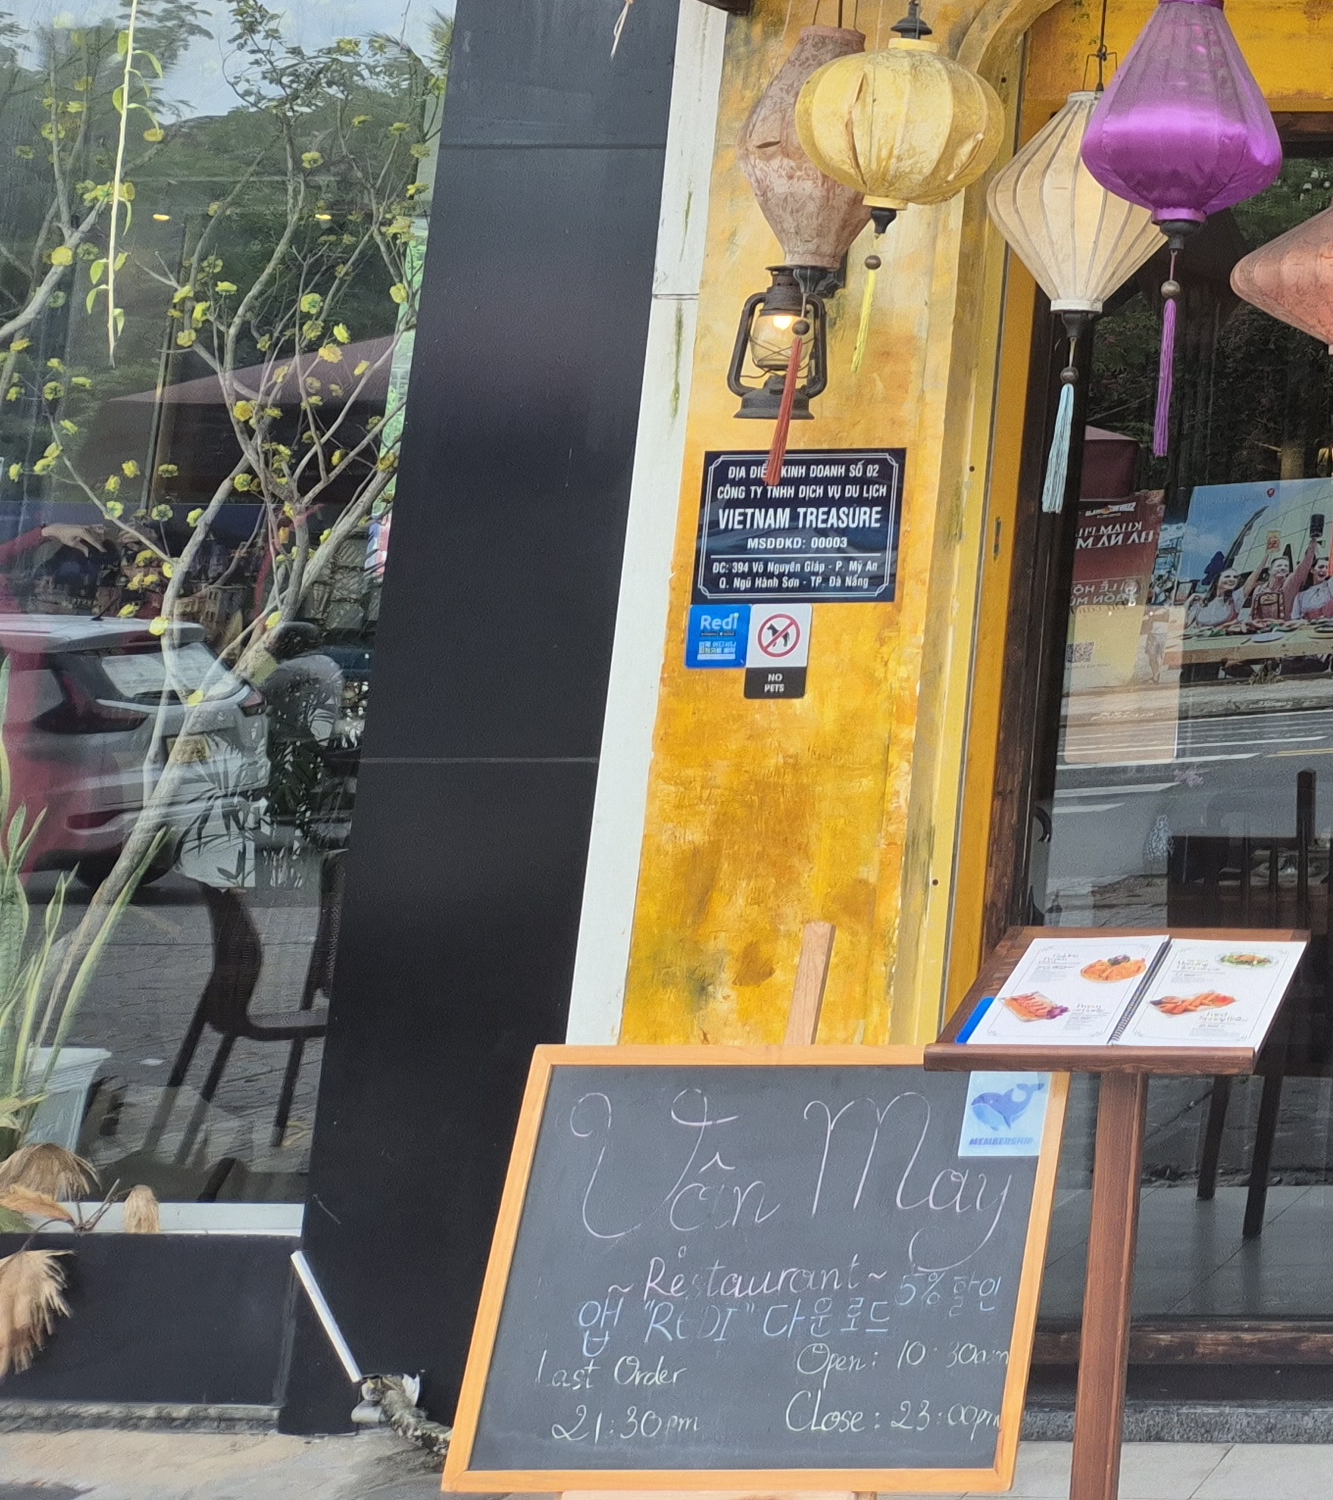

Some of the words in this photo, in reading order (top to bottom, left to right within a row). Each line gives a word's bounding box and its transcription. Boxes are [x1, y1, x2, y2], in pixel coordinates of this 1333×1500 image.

[781, 465, 806, 478] KINH
[809, 464, 845, 479] DOANH
[849, 460, 865, 478] SỐ
[866, 464, 879, 477] 02
[717, 484, 746, 499] CÔNG
[750, 486, 763, 499] TY
[766, 485, 795, 499] TNHH
[798, 485, 824, 501] DỊCH
[827, 485, 842, 500] VỤ
[845, 484, 859, 498] DU
[863, 484, 887, 500] LỊCH
[718, 507, 790, 530] VIETNAM
[797, 506, 882, 529] TREASURE
[810, 536, 848, 548] 00003
[732, 561, 749, 573] 394
[804, 560, 825, 575] Giáp
[849, 560, 863, 573] Mỹ
[866, 560, 878, 572] An
[755, 576, 778, 588] Hành
[782, 576, 800, 588] Sơn
[700, 612, 740, 630] Redi
[768, 673, 783, 682] NO
[764, 683, 784, 693] PETS
[968, 1136, 1034, 1146] MEMBERSHIP
[613, 1355, 688, 1386] Order
